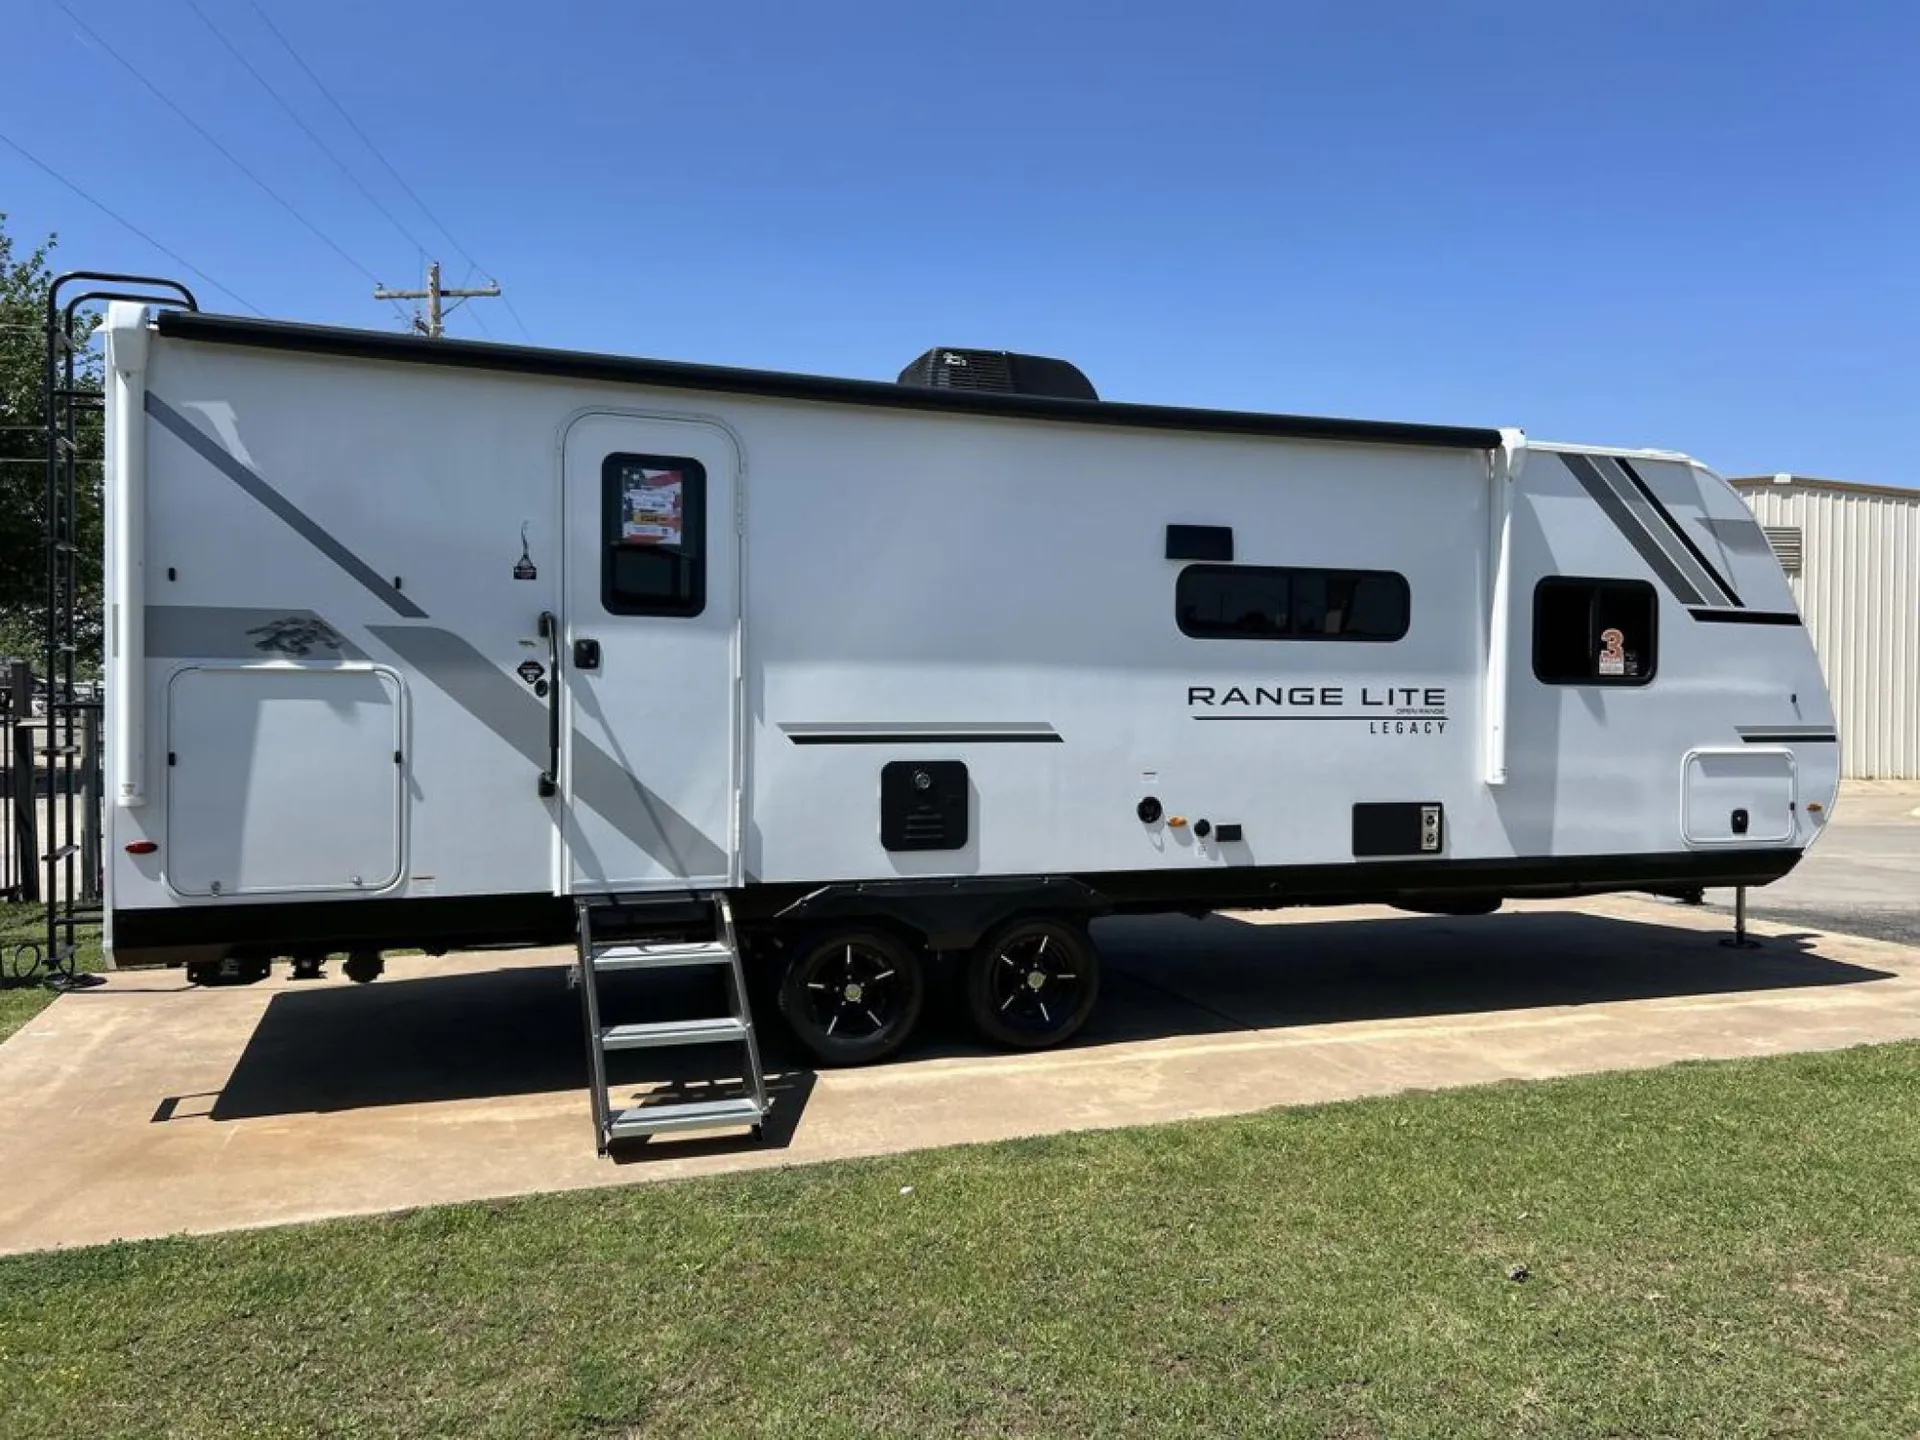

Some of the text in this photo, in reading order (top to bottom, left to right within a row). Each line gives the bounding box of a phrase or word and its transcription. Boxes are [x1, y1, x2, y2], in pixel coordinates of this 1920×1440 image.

[1601, 628, 1624, 660] 3
[1188, 687, 1446, 706] RANGE LITE
[1370, 721, 1446, 734] LEGACY
